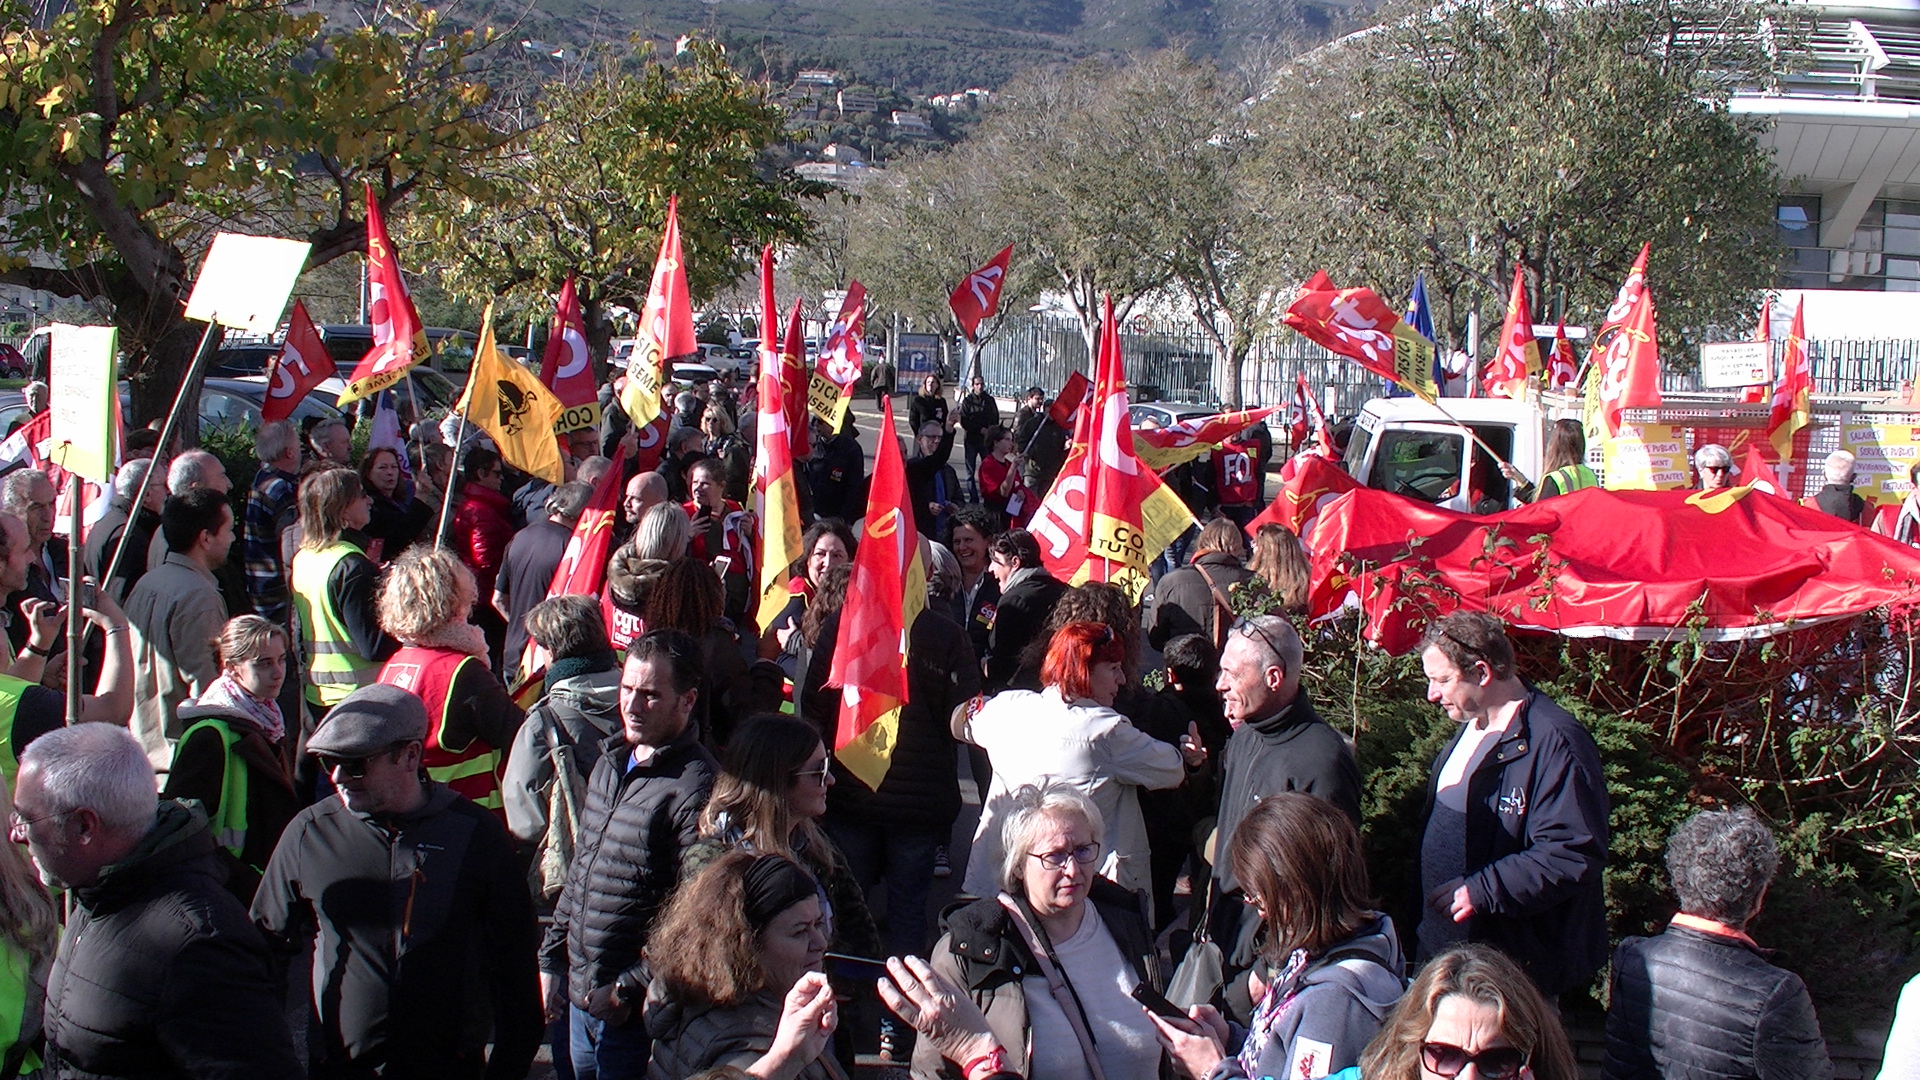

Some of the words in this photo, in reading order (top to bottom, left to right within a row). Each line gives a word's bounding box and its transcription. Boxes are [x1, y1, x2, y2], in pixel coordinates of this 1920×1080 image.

[1397, 338, 1411, 381] ORSICA
[1849, 429, 1881, 442] SALAIRES
[1859, 446, 1888, 457] SERVICES
[614, 607, 641, 636] cgt
